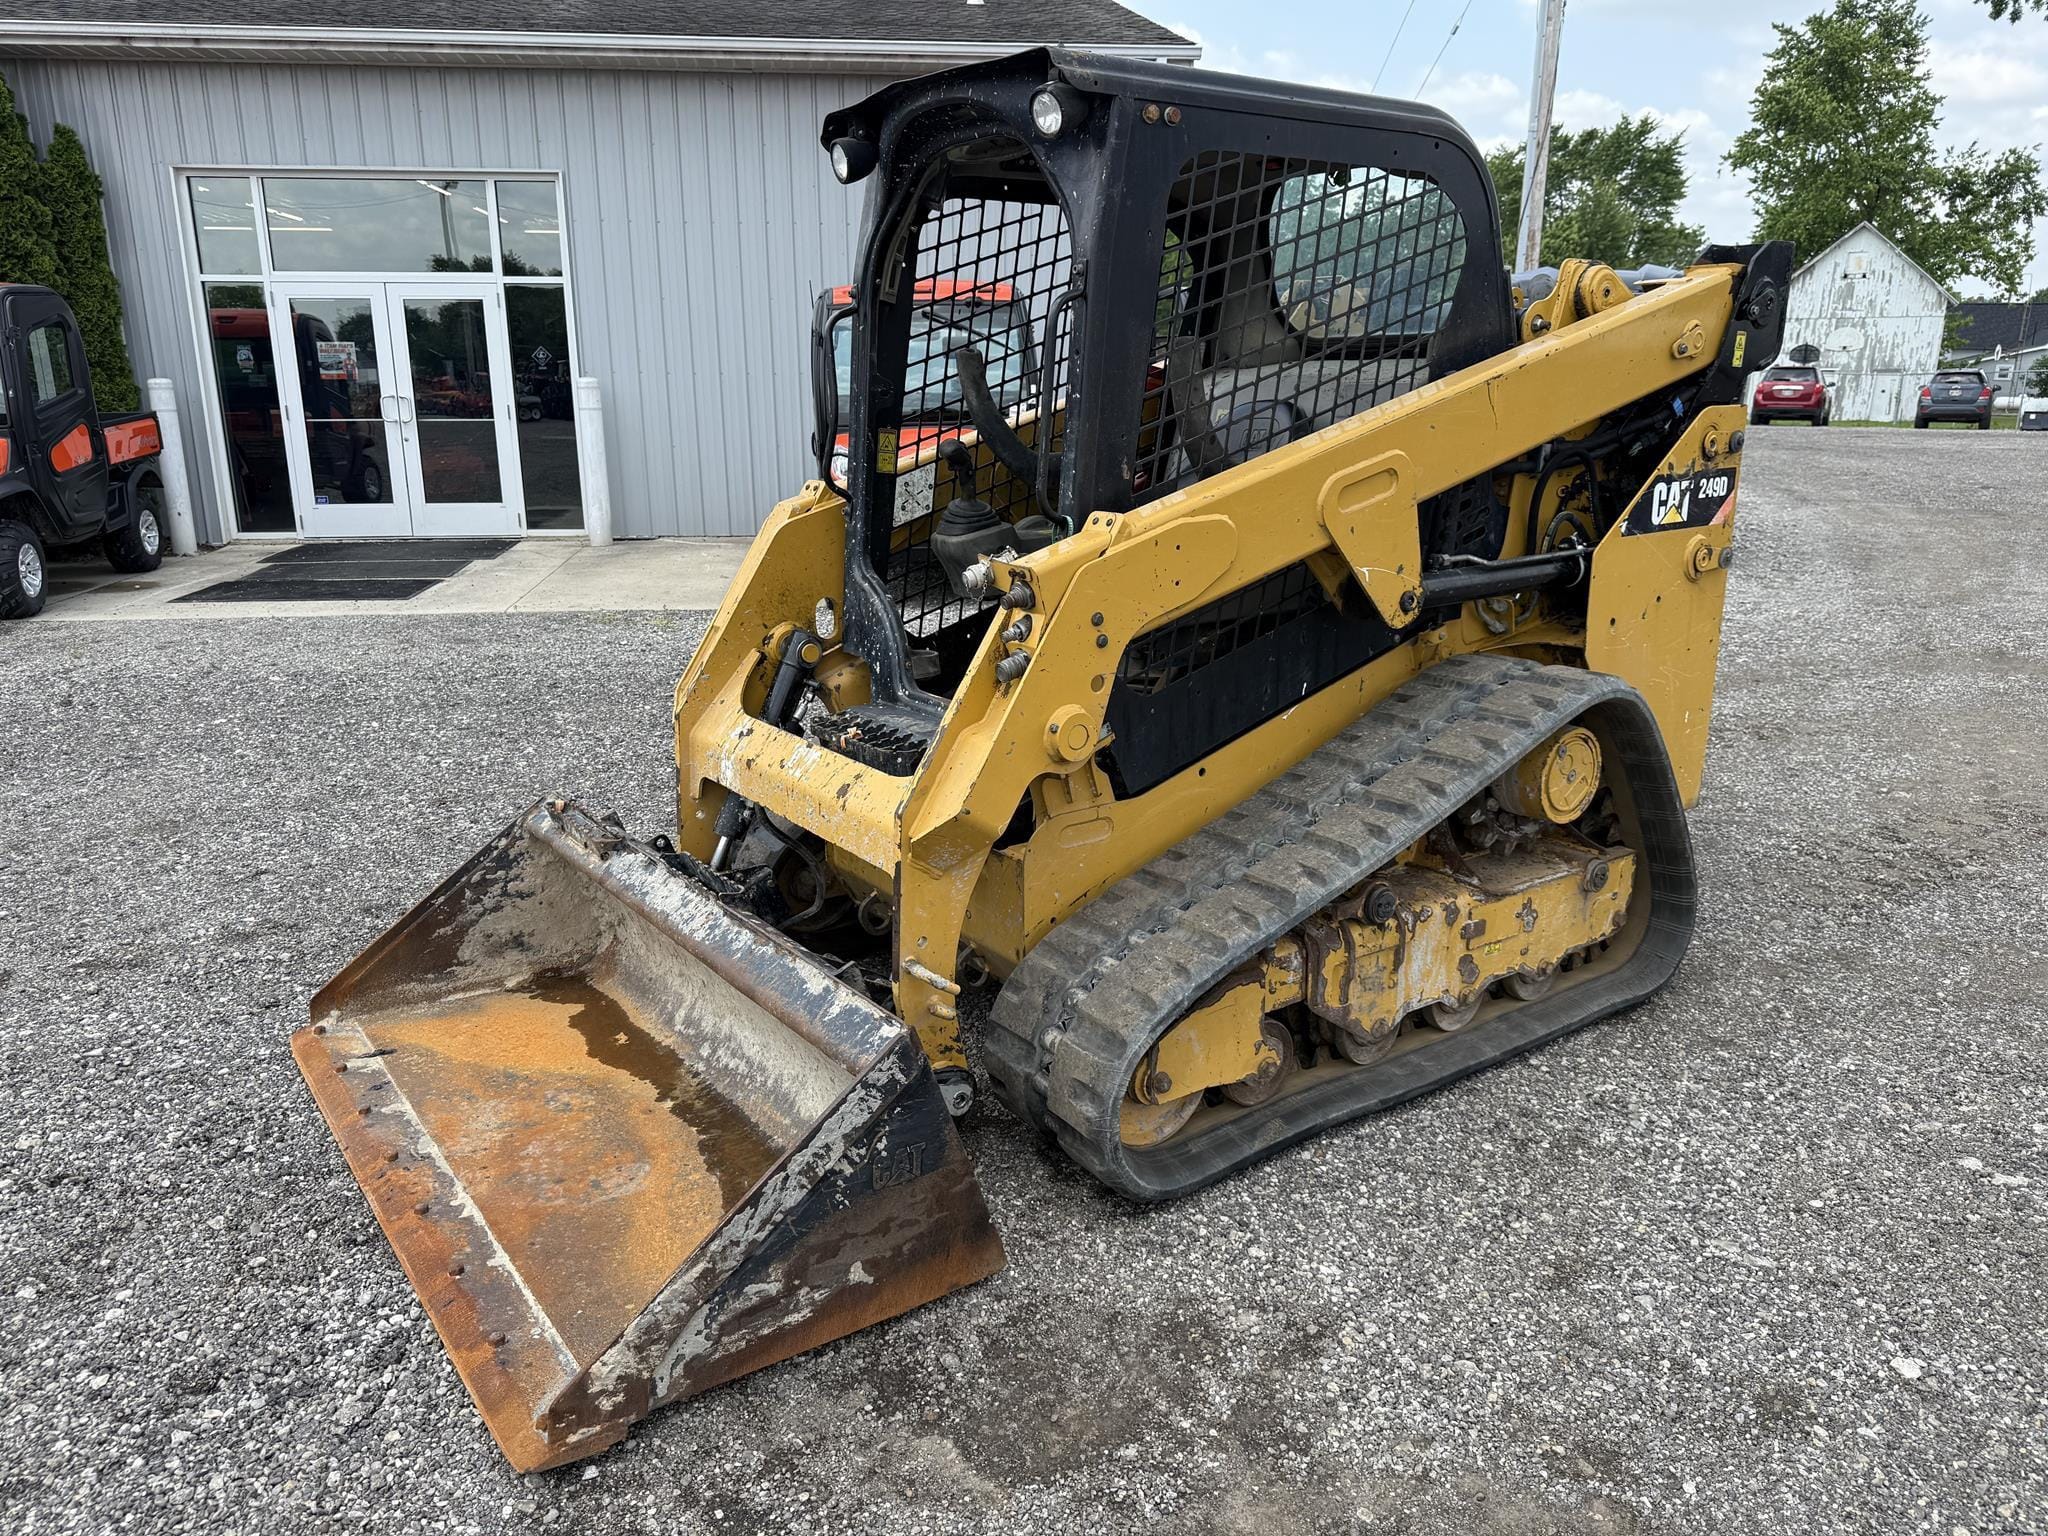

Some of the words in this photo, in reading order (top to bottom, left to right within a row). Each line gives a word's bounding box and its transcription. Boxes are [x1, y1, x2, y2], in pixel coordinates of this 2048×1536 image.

[1651, 480, 1694, 526] CAT
[1698, 476, 1728, 499] 249D
[872, 1141, 927, 1191] CAT
